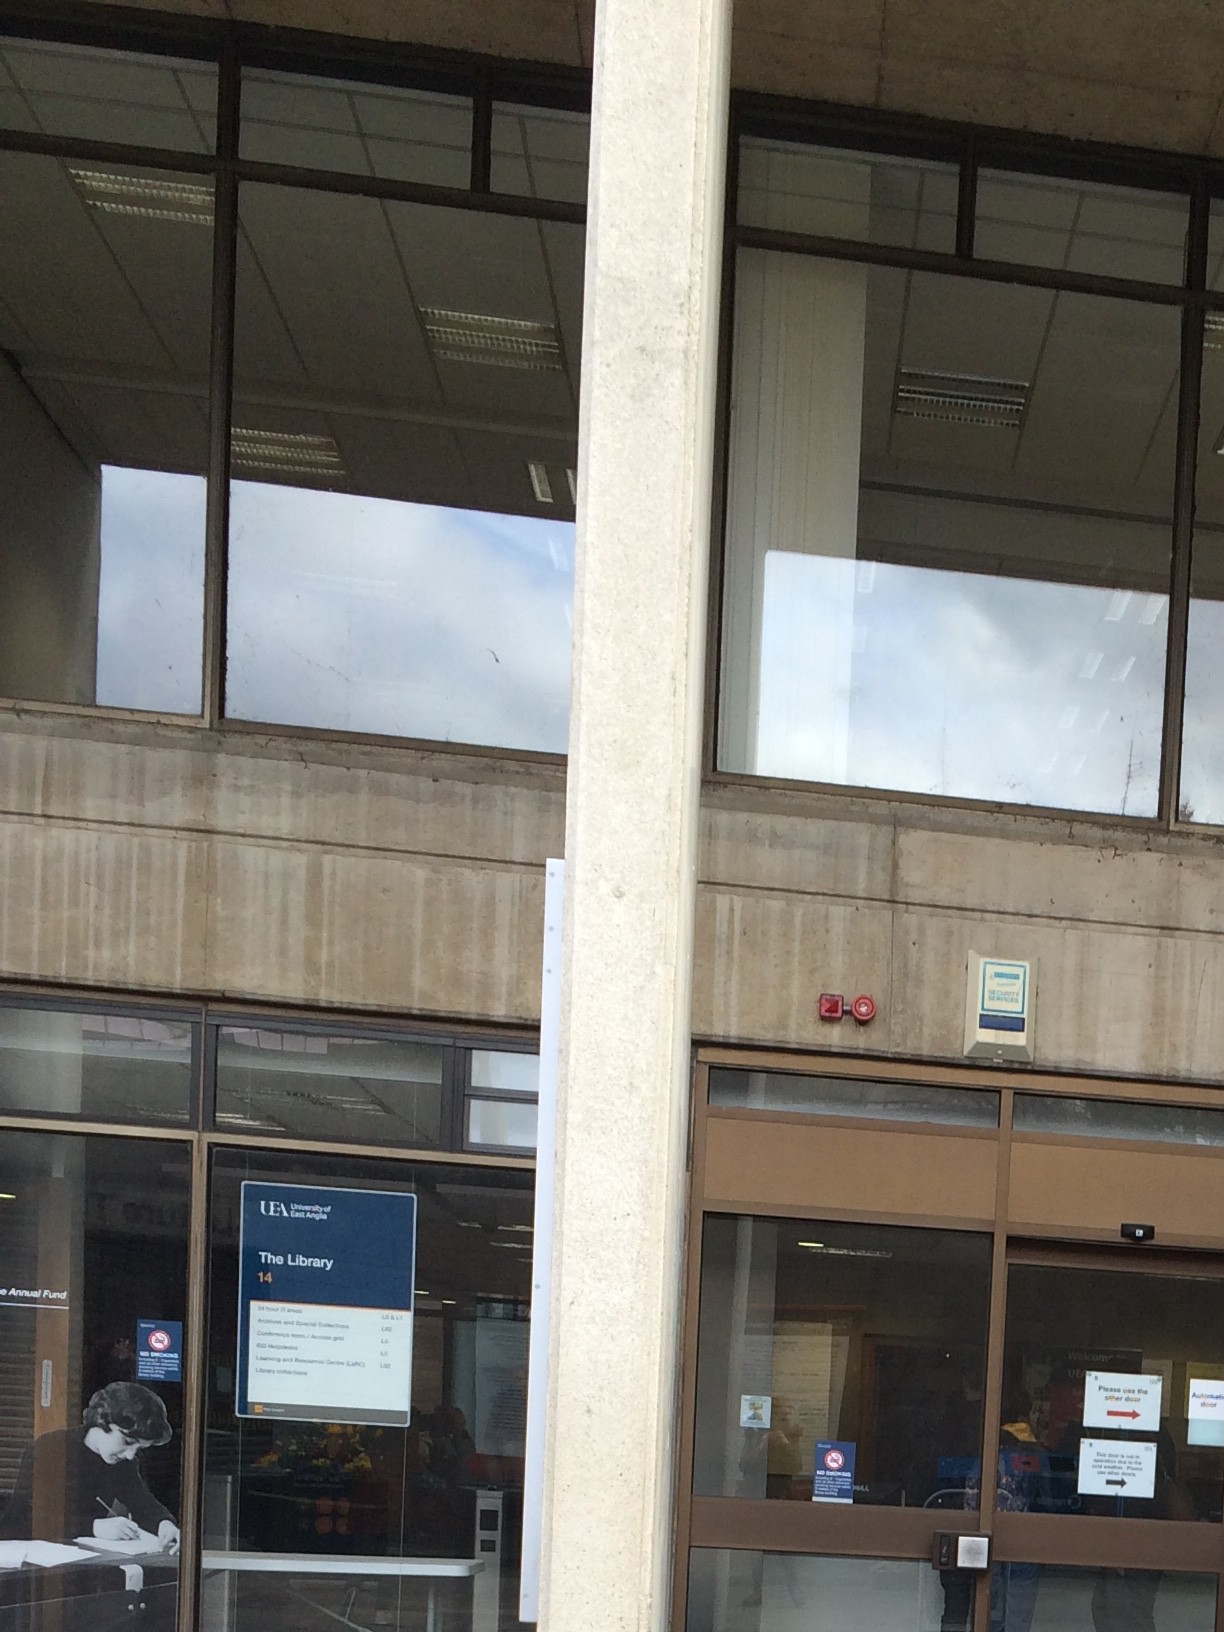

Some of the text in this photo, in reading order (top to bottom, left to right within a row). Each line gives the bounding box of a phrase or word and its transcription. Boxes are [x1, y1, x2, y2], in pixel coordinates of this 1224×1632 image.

[260, 1201, 289, 1217] UEA
[290, 1203, 322, 1212] University
[306, 1212, 328, 1220] Anglia
[258, 1251, 334, 1271] The Library
[257, 1271, 273, 1284] 14
[8, 1288, 42, 1298] Annual
[42, 1290, 68, 1300] Fund
[1098, 1386, 1122, 1394] Please
[1137, 1387, 1148, 1395] the
